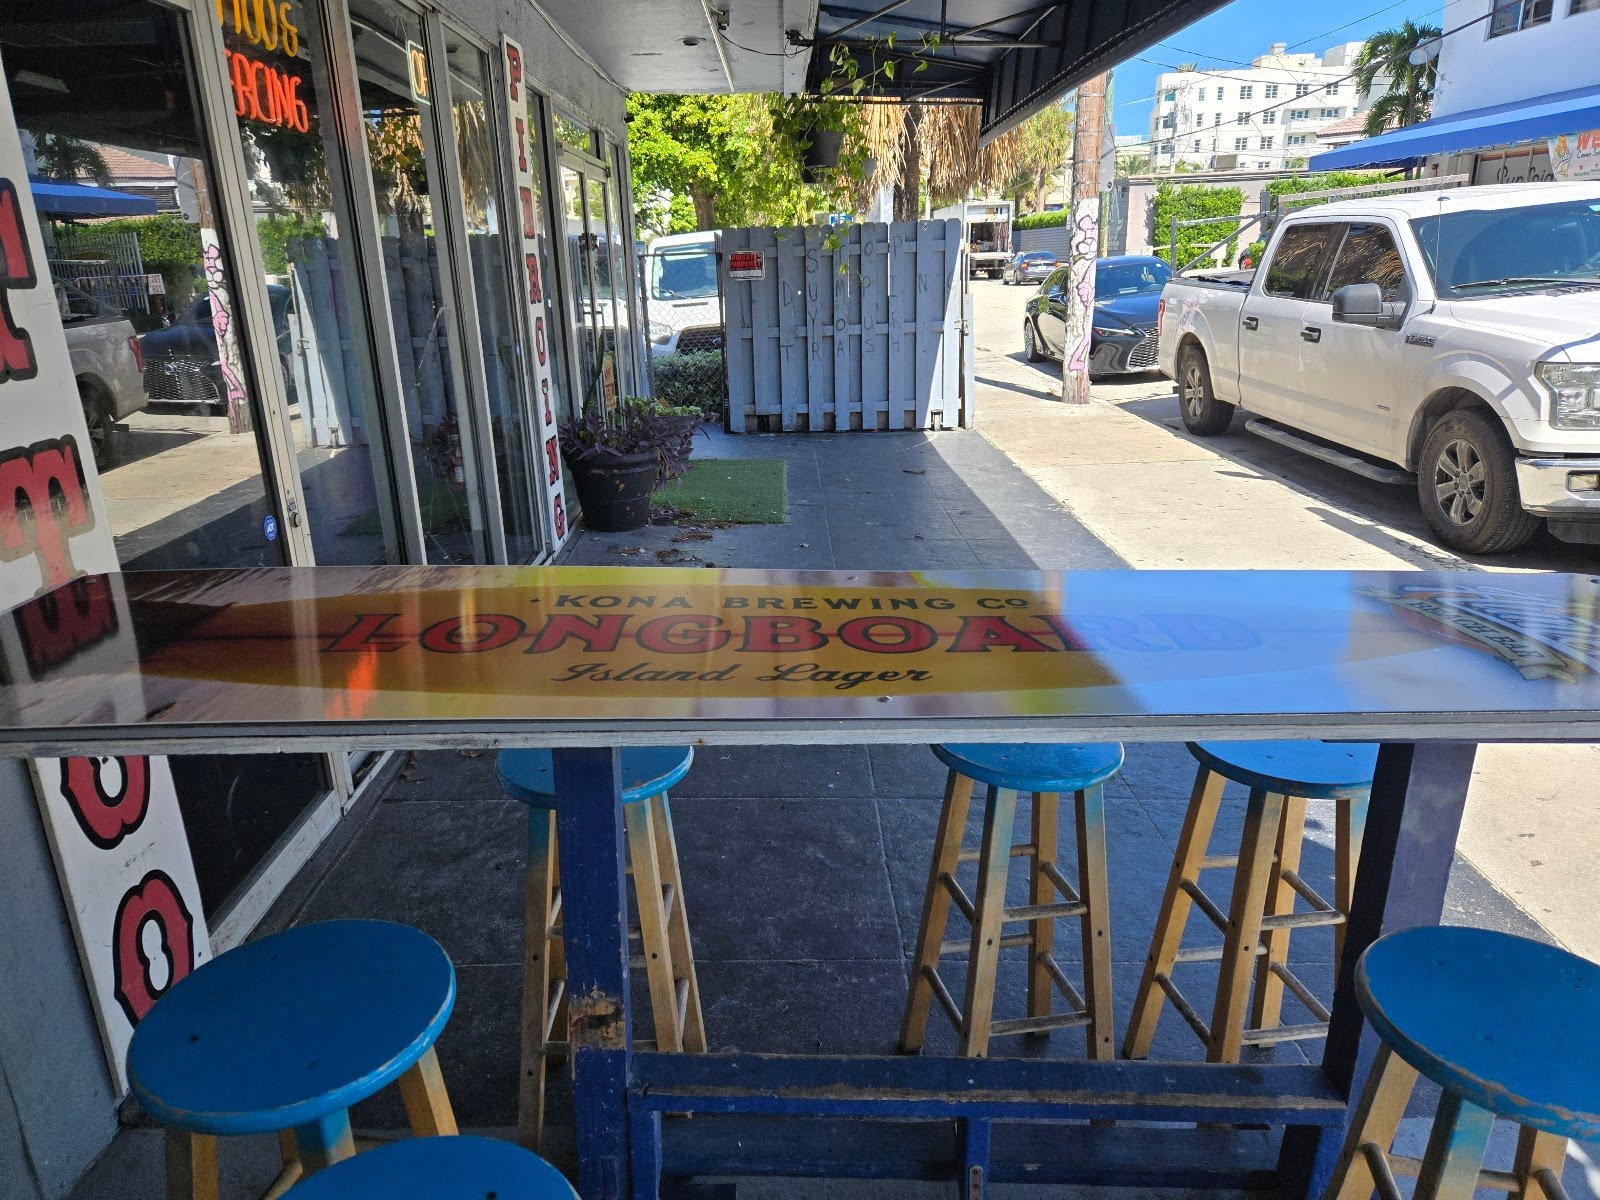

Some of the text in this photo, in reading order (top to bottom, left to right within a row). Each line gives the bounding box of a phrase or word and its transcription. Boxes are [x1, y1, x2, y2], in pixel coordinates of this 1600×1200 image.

[224, 48, 309, 133] RCING
[507, 42, 565, 540] PIERCING
[555, 595, 693, 609] KONA
[723, 596, 956, 610] BREWING
[1407, 601, 1498, 633] BEACH
[320, 613, 1264, 654] LONGBOARD
[551, 662, 933, 691] Island Lager
